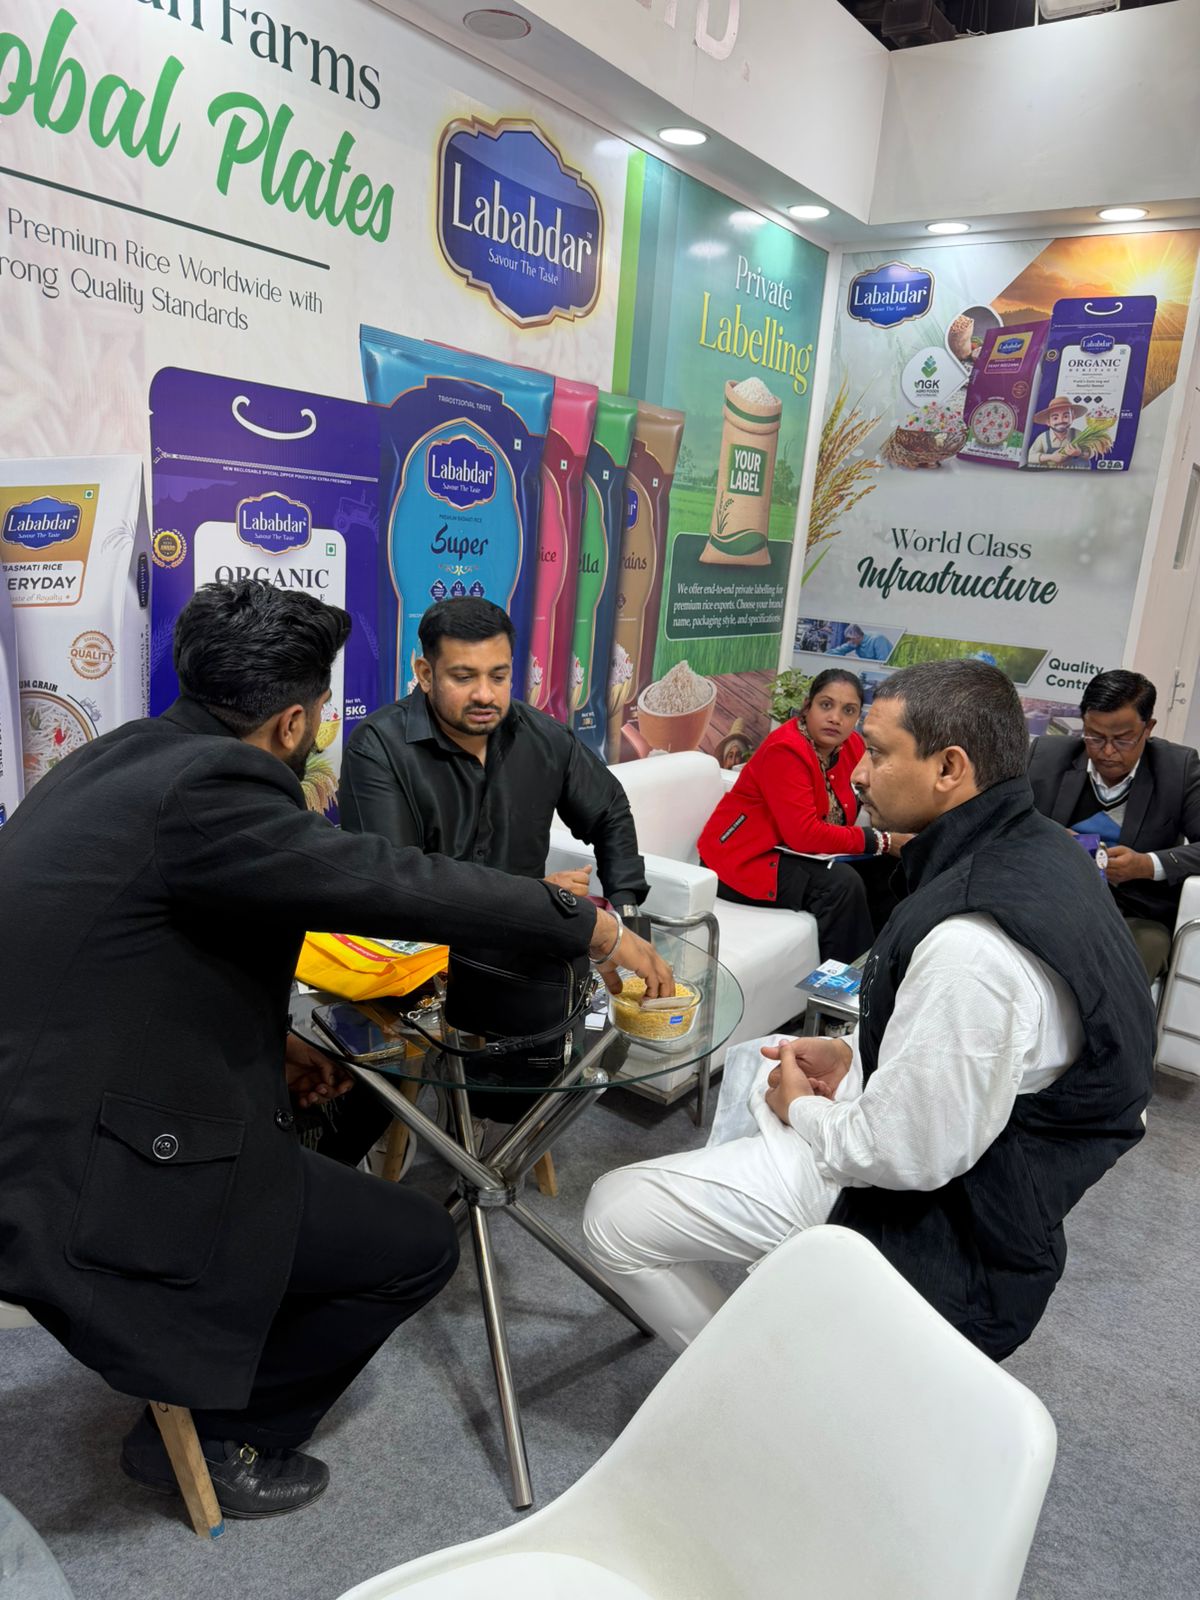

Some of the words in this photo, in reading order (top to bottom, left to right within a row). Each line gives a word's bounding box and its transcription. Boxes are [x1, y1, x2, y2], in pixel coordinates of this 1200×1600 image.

[220, 0, 381, 109] Farms
[207, 92, 394, 242] Plates
[452, 161, 592, 274] Lababdar
[8, 207, 117, 261] Premium
[126, 239, 170, 273] Rice
[179, 254, 282, 302] Worldwide
[289, 290, 323, 314] with
[488, 248, 519, 271] Savour
[520, 259, 537, 278] The
[539, 266, 559, 285] Taste
[735, 255, 792, 311] Private
[854, 283, 927, 306] Lababdar
[71, 268, 143, 314] Quality
[152, 286, 248, 330] Standards
[700, 291, 813, 395] Labelling
[1068, 359, 1121, 367] ORGANIC
[432, 454, 492, 485] Lababdar
[734, 449, 761, 472] YOUR
[730, 470, 760, 492] LABEL
[8, 513, 76, 532] Lababdar
[243, 510, 307, 533] Lababdar
[431, 522, 488, 561] Super
[891, 528, 962, 555] World
[967, 532, 1032, 560] Class
[540, 546, 557, 562] ice
[42, 563, 63, 571] RICE
[215, 565, 329, 588] ORGANIC
[7, 576, 76, 590] ERYDAY
[677, 583, 688, 594] We
[857, 556, 1059, 605] Infrastructure
[70, 648, 115, 662] QUALITY
[1049, 658, 1104, 675] Quality
[32, 680, 58, 692] GRAIN
[1046, 674, 1088, 690] Contr
[345, 705, 367, 716] 5KG
